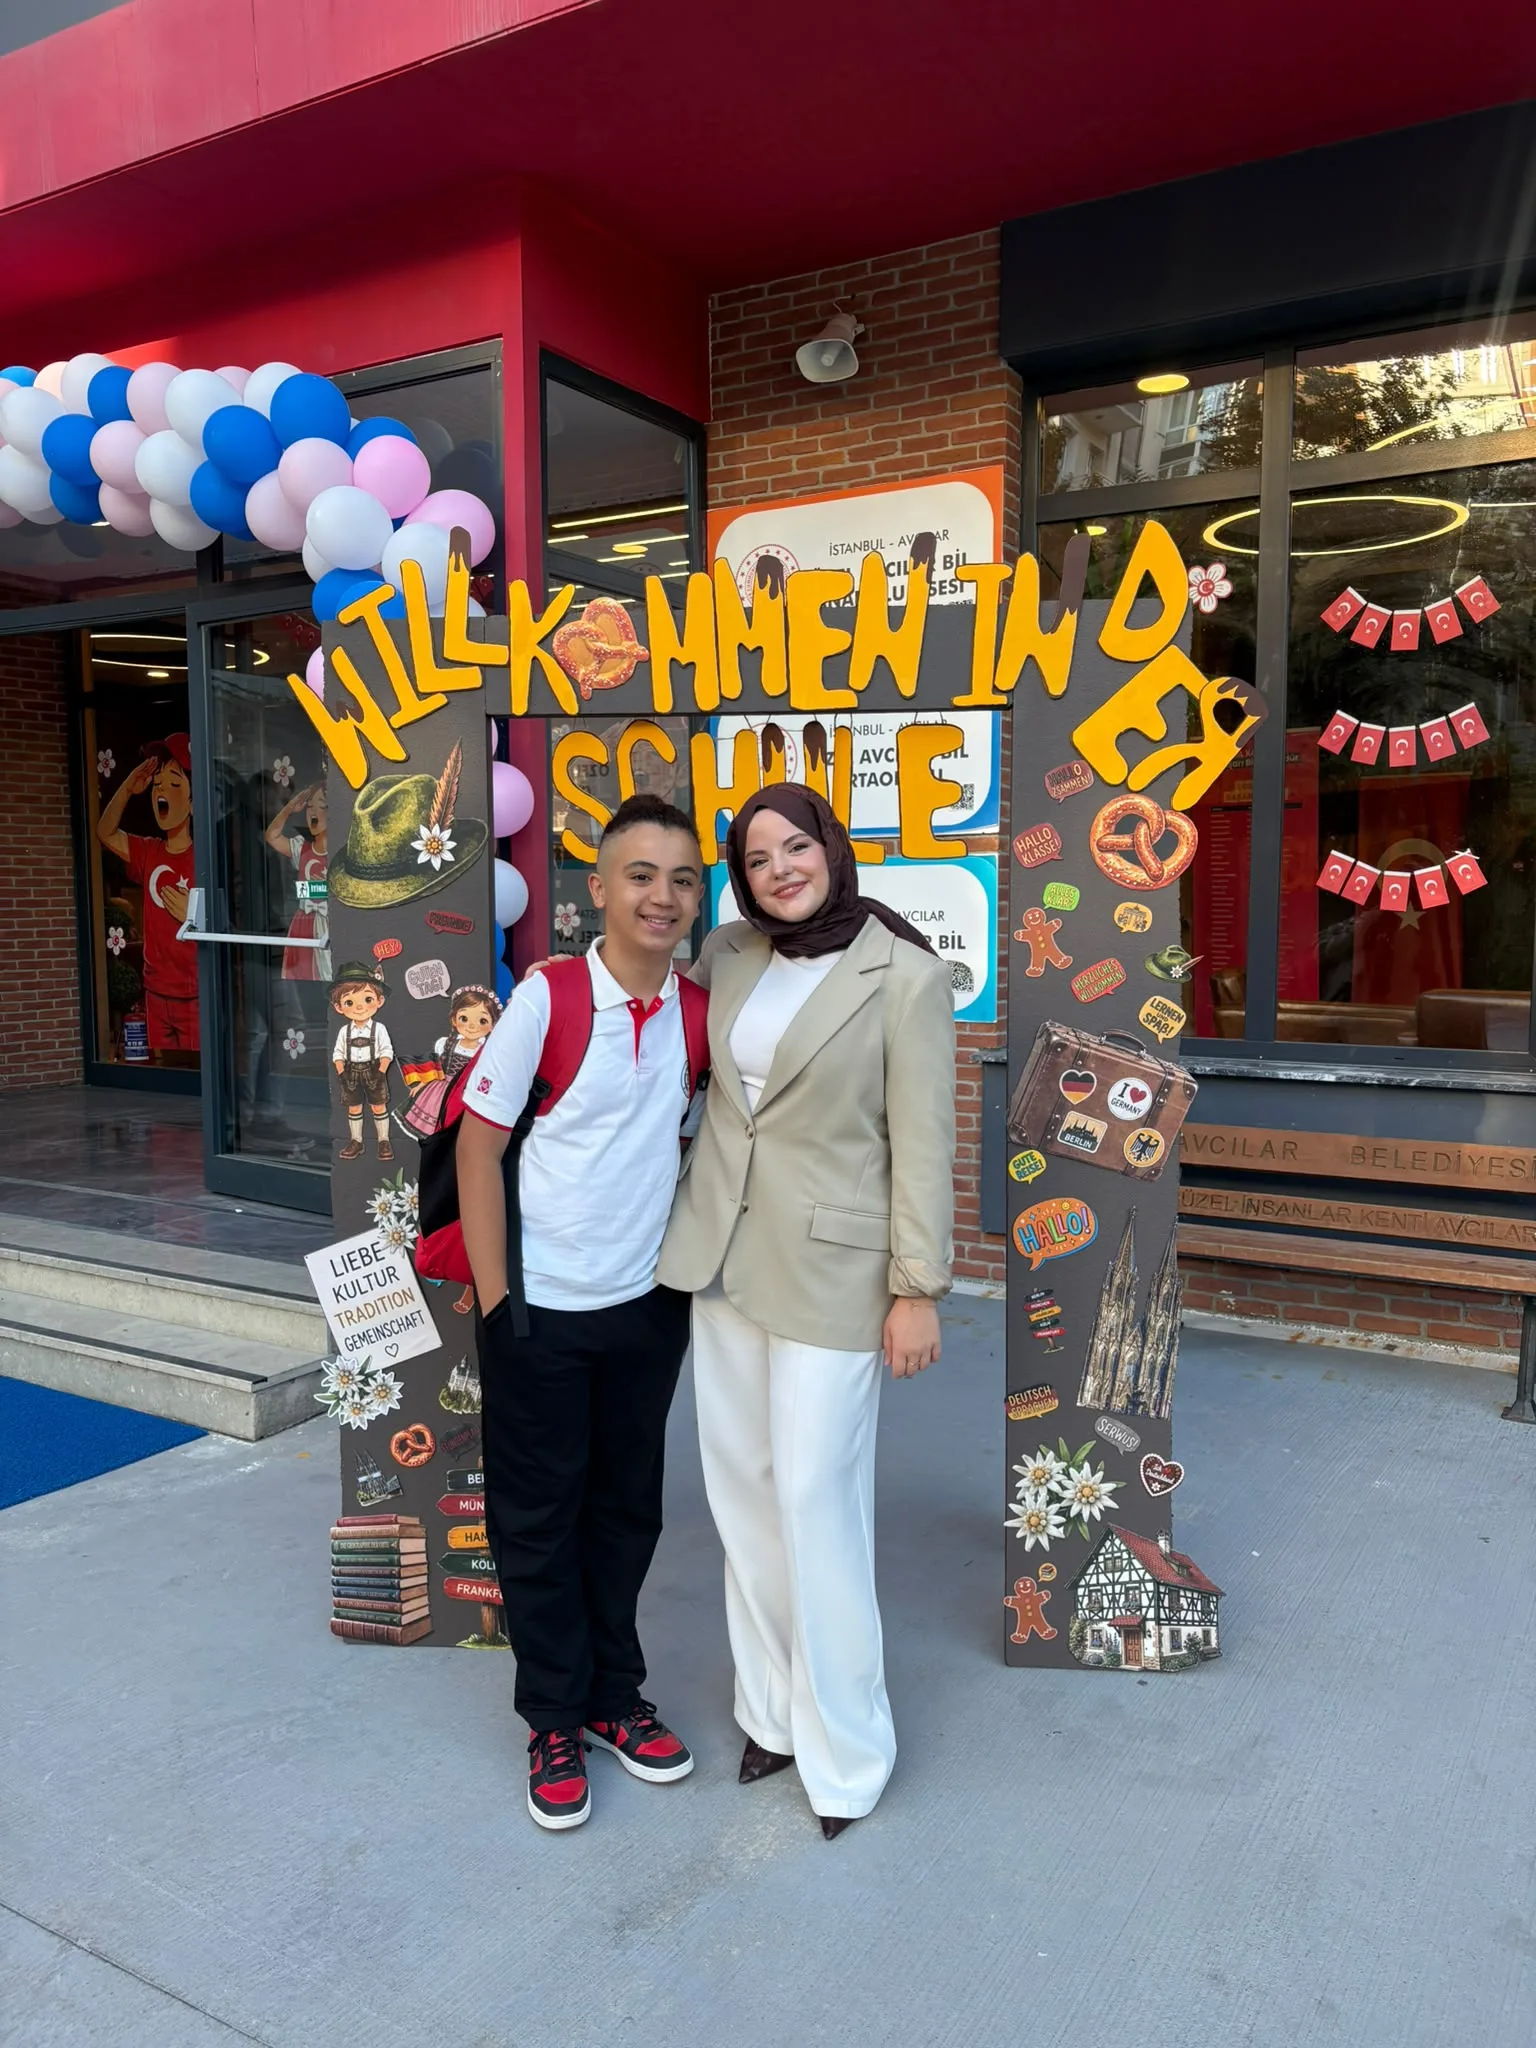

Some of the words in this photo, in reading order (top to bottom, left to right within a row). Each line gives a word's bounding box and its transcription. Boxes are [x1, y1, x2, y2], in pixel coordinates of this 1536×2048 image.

[829, 538, 886, 557] İSTANBUL
[898, 528, 950, 548] AVAR
[951, 533, 1092, 707] IN
[1071, 519, 1270, 811] DER
[1048, 763, 1082, 787] HALLO
[1051, 773, 1091, 797] ZSAMMEN!
[1016, 827, 1052, 853] HALLO
[1021, 838, 1059, 865] KLASSE!
[1046, 894, 1075, 909] KLAR?
[1049, 884, 1076, 898] ALLES
[897, 910, 946, 923] VCILAR
[376, 940, 399, 956] HEY!
[938, 930, 967, 951] BİL
[415, 977, 444, 997] TAG!
[1073, 959, 1119, 991] HERZLICHES
[1077, 969, 1125, 1002] WILLKOMMEN!
[1150, 997, 1185, 1024] LERNEN
[1156, 1012, 1169, 1022] UND
[1117, 1082, 1131, 1098] I
[1110, 1097, 1143, 1116] GERMANY
[1064, 1133, 1093, 1149] BERLIN
[1180, 1132, 1299, 1161] AVCILAR
[1013, 1151, 1036, 1169] GUTE
[1015, 1160, 1046, 1180] REISE!
[1180, 1188, 1235, 1213] ÜZEL
[1016, 1206, 1092, 1254] HALLO!
[329, 1240, 386, 1278] LIEBE
[332, 1265, 400, 1304] KULTUR
[334, 1286, 416, 1330] TRADITION
[344, 1309, 426, 1353] GEMEINSCHAFT
[1007, 1384, 1052, 1407] DEUTSCH
[1097, 1418, 1139, 1449] SERWUS!
[471, 1558, 496, 1571] KÖL
[456, 1583, 504, 1600] FRANKF
